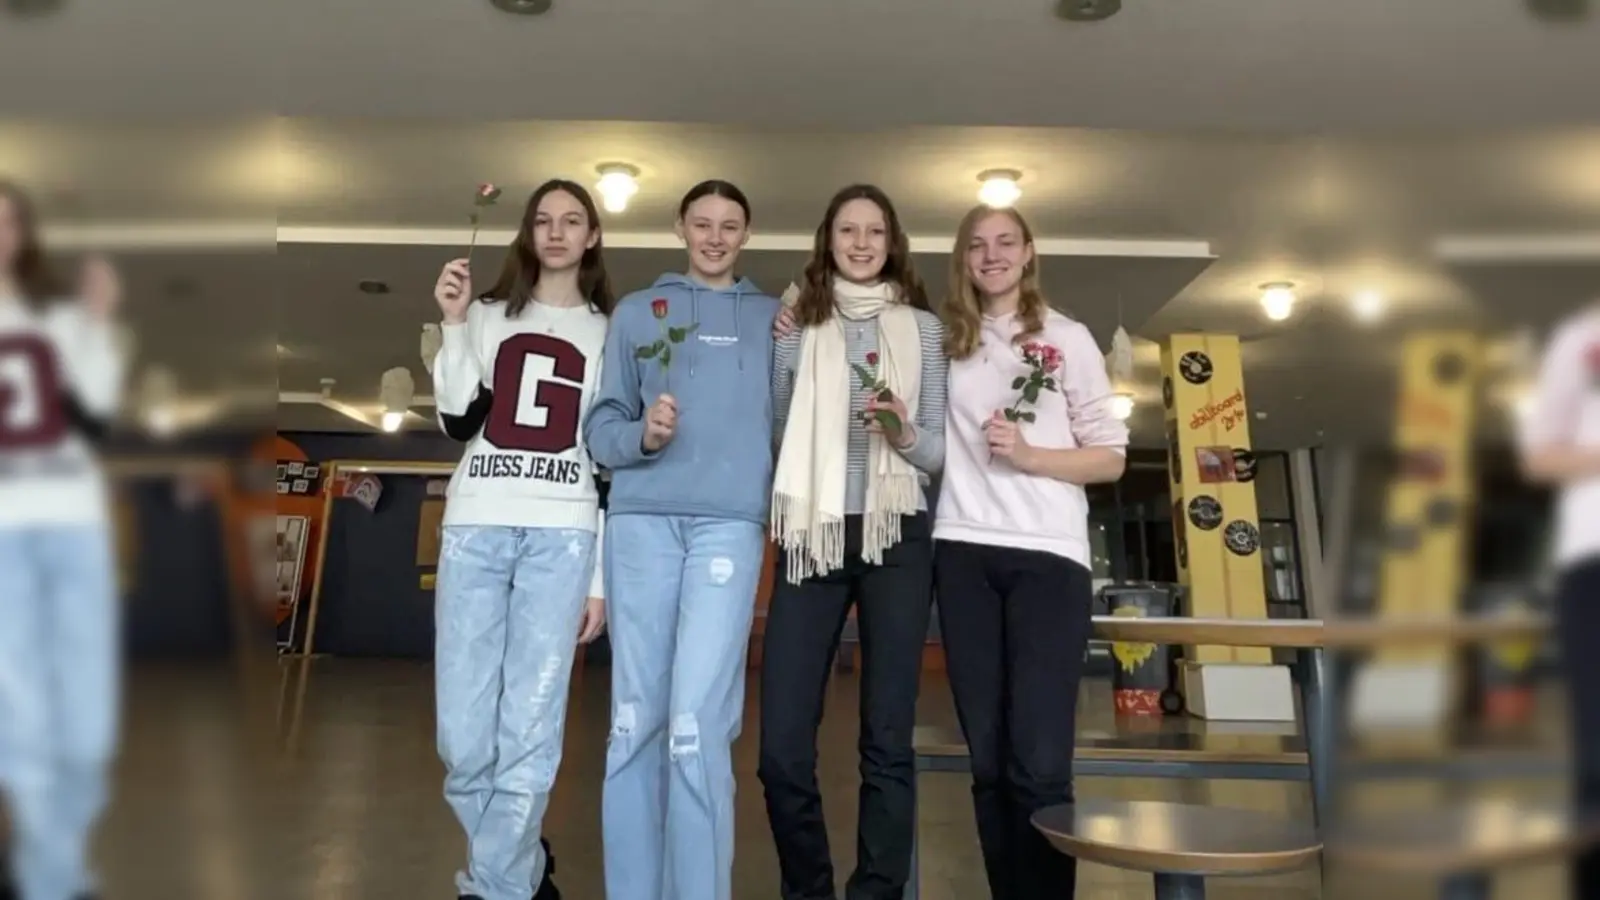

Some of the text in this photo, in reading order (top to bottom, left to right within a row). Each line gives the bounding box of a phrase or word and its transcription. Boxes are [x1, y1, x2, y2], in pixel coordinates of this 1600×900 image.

[483, 332, 586, 454] G
[468, 454, 581, 485] GUESS JEANS
